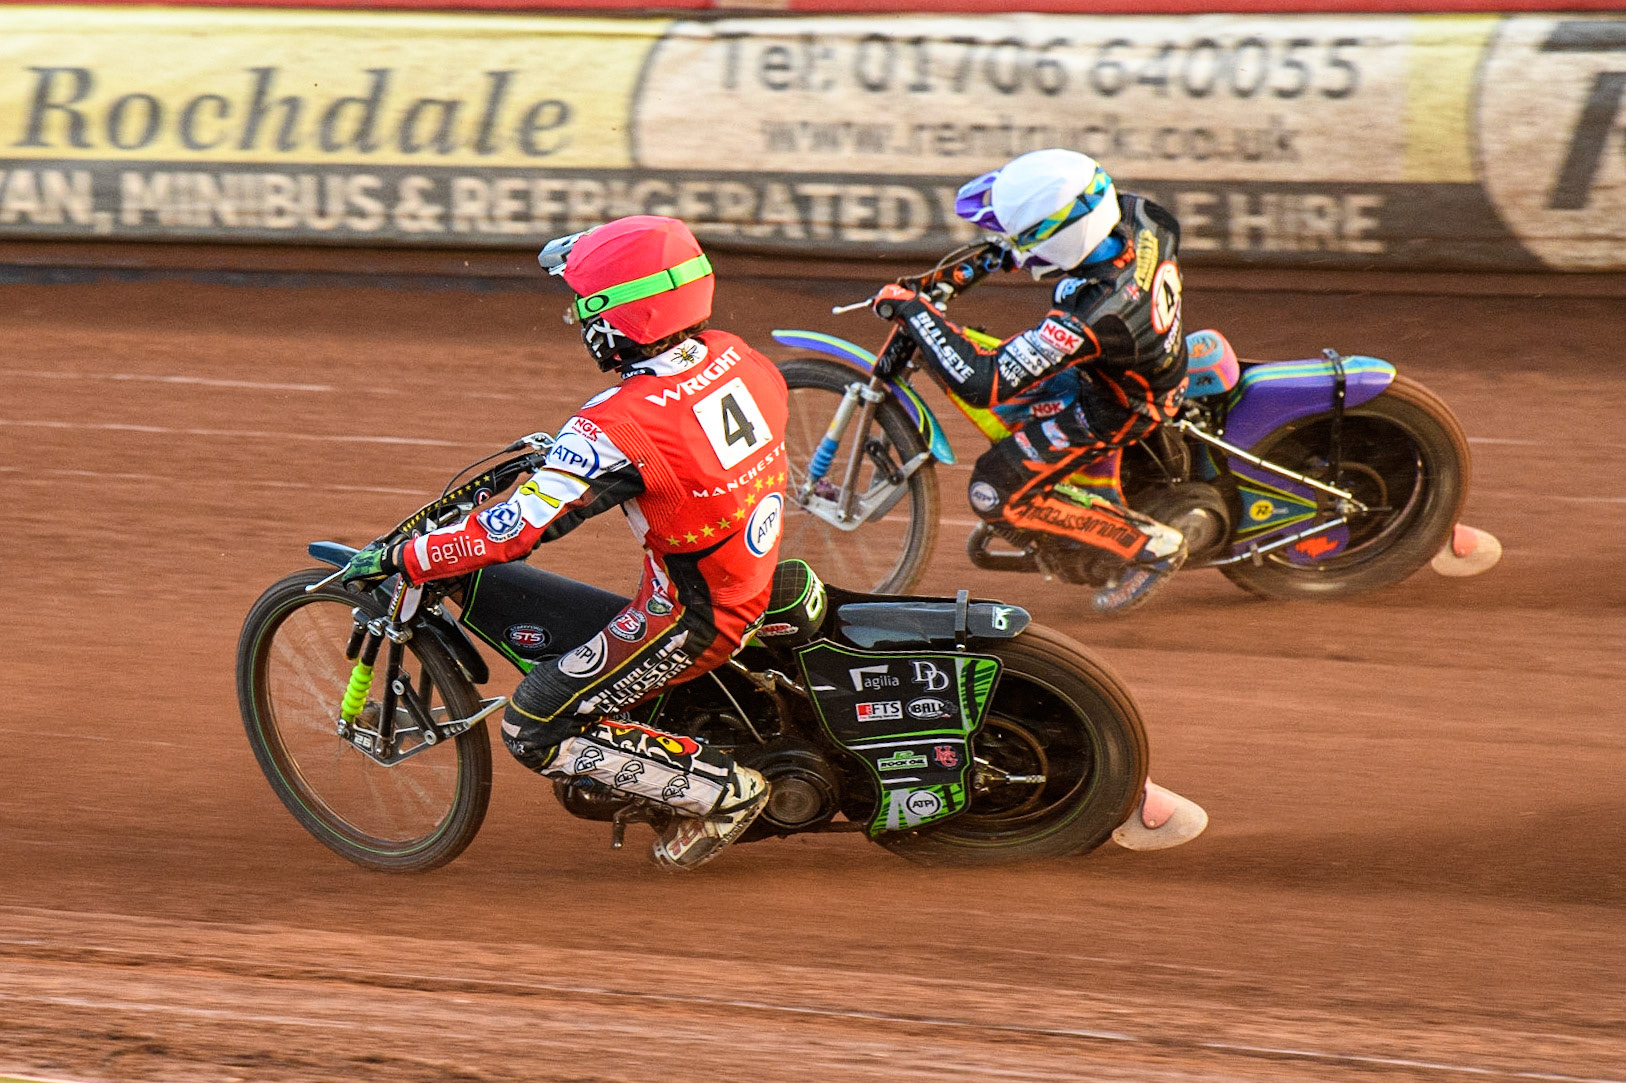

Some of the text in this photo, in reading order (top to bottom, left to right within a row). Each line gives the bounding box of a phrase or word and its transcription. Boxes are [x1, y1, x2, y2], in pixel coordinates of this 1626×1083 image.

[855, 32, 1069, 95] 01706
[1088, 36, 1361, 99] 640055
[18, 65, 572, 157] Rochdale
[0, 169, 113, 234] AN,
[121, 171, 386, 232] MINIBUS
[393, 175, 446, 233] &
[450, 176, 932, 243] REFRIGERATED
[916, 311, 975, 379] BULLSEYE
[1043, 323, 1080, 349] NGK
[645, 346, 742, 407] WRIGHT
[575, 418, 602, 440] NGK
[720, 393, 757, 448] 4
[552, 445, 588, 468] ATPI
[757, 507, 779, 543] ATPI
[431, 536, 487, 565] agilia
[511, 632, 542, 642] STS
[613, 657, 656, 690] MALC
[864, 675, 900, 691] agilia
[872, 702, 900, 715] FTS
[912, 799, 935, 809] ATPI
